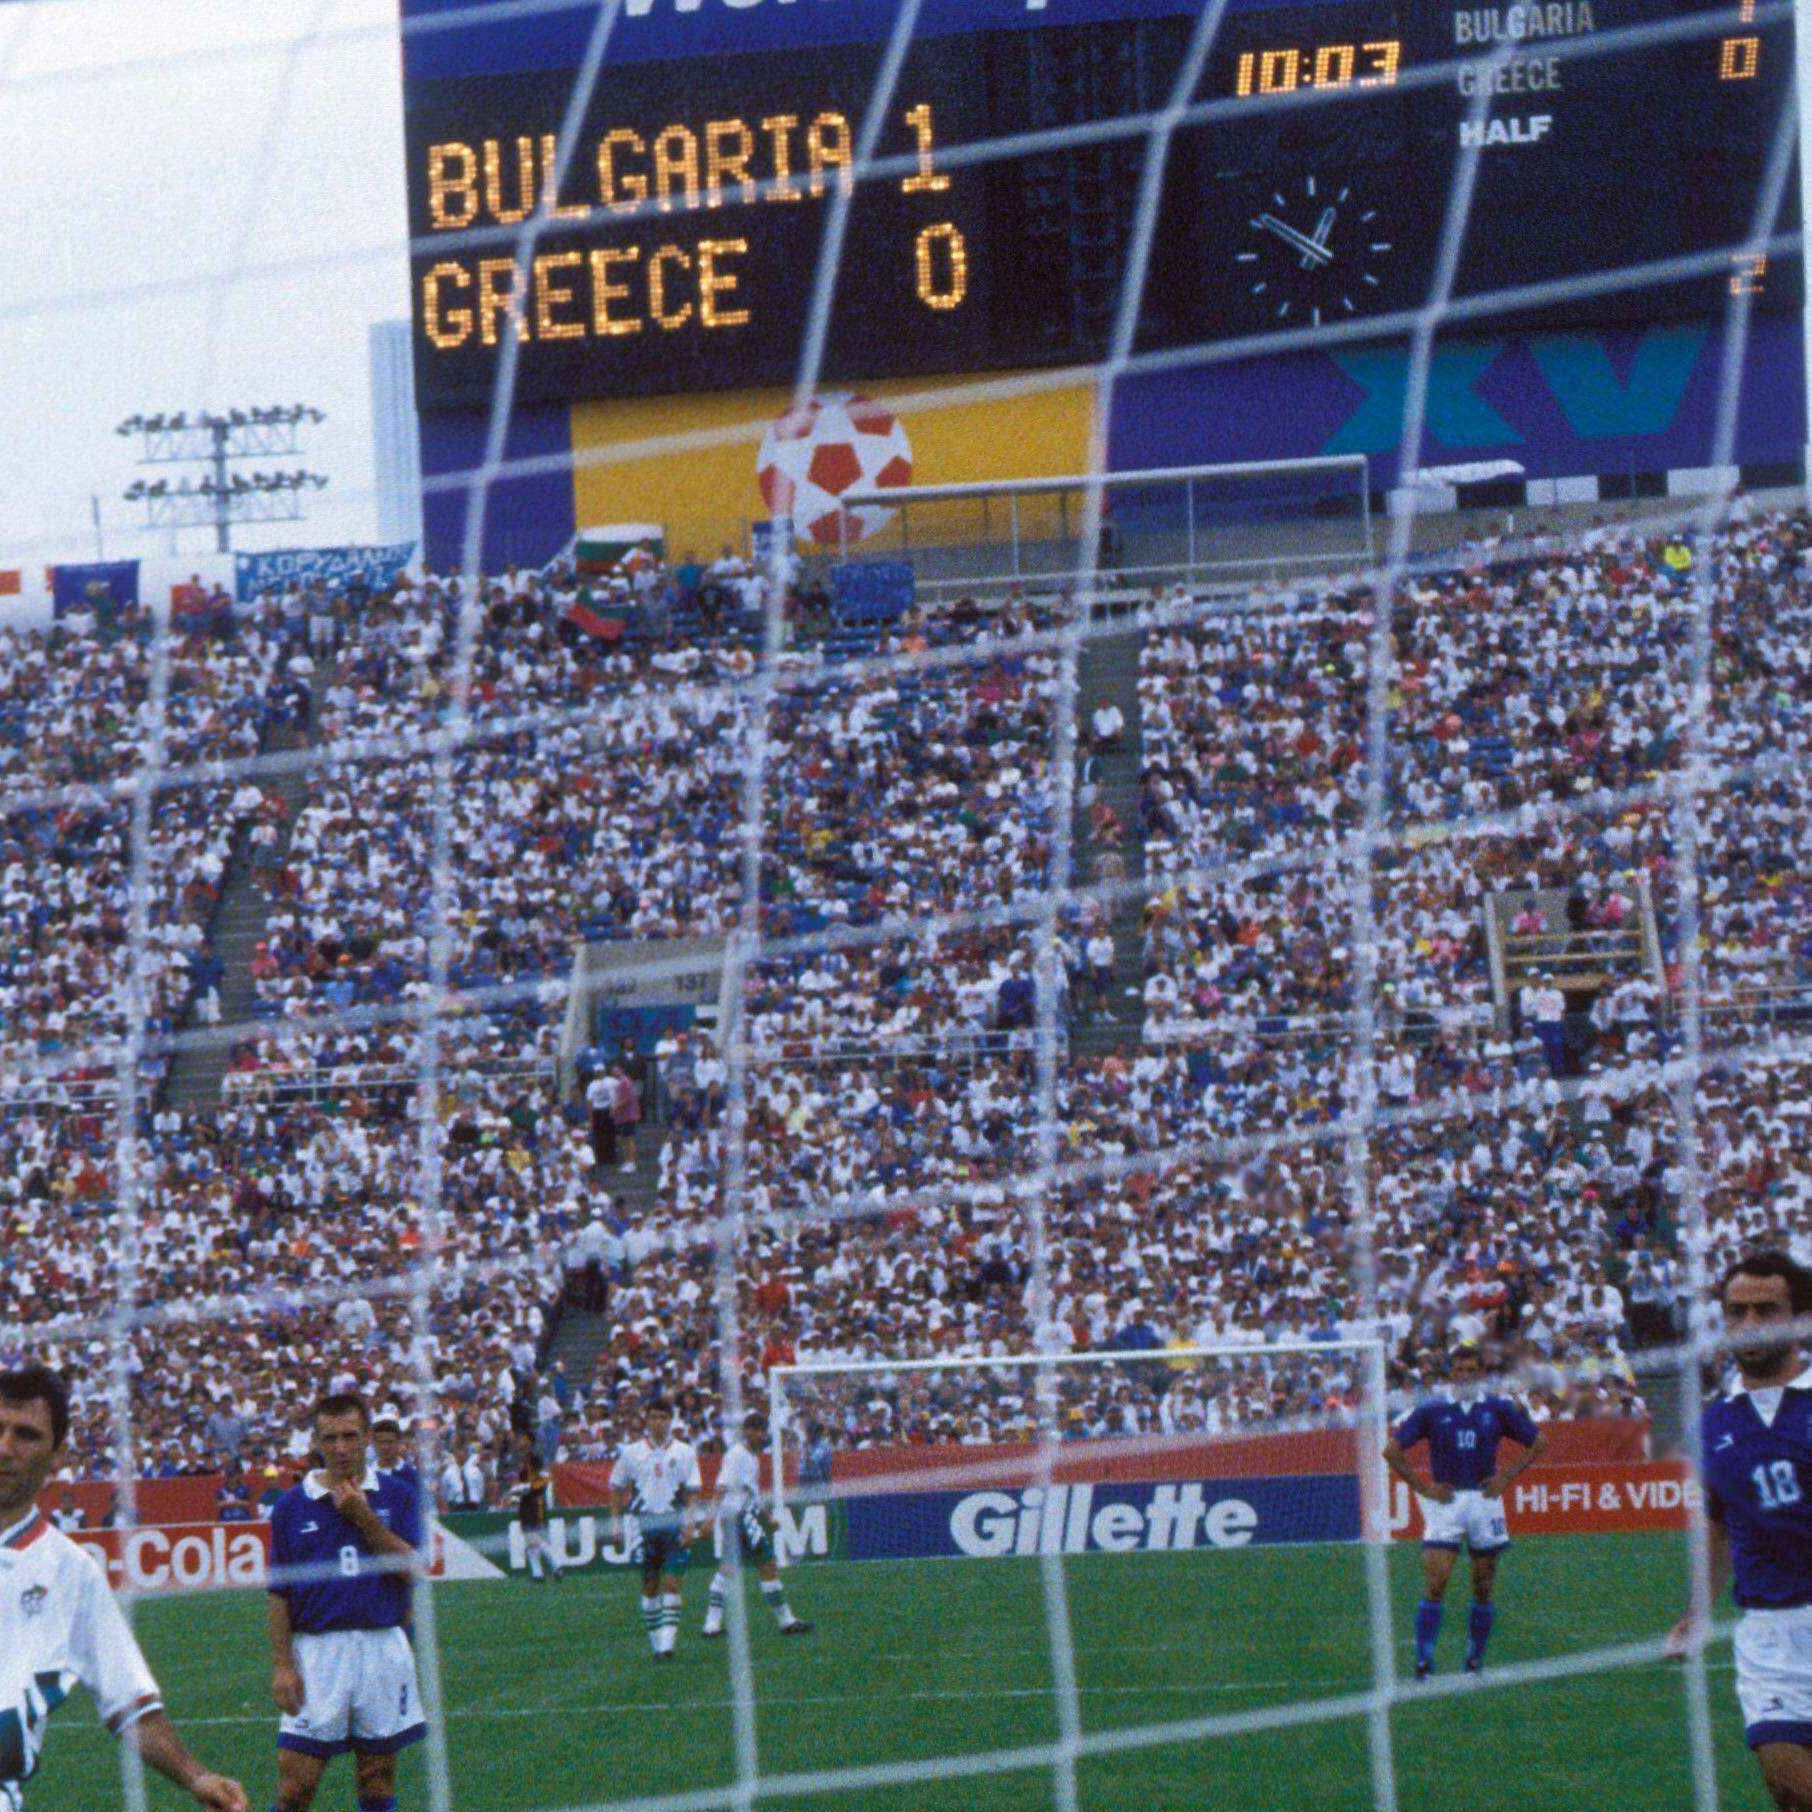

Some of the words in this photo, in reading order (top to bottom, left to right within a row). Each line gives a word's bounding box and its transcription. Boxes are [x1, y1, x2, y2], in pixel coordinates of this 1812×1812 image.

[1456, 3, 1593, 42] BULGARIA
[1237, 40, 1401, 97] 10:03
[1458, 57, 1561, 97] GREECE
[1459, 115, 1553, 147] HALF
[428, 112, 854, 229] BULGARIA
[901, 104, 950, 193] 1
[422, 238, 749, 348] GREECE
[915, 222, 966, 309] 0
[950, 1484, 1258, 1555] Gillette
[1515, 1485, 1591, 1513] HI-FI
[1597, 1482, 1621, 1511] &
[1623, 1478, 1703, 1510] VIDE
[76, 1527, 268, 1588] -Cola
[339, 1544, 360, 1577] 8
